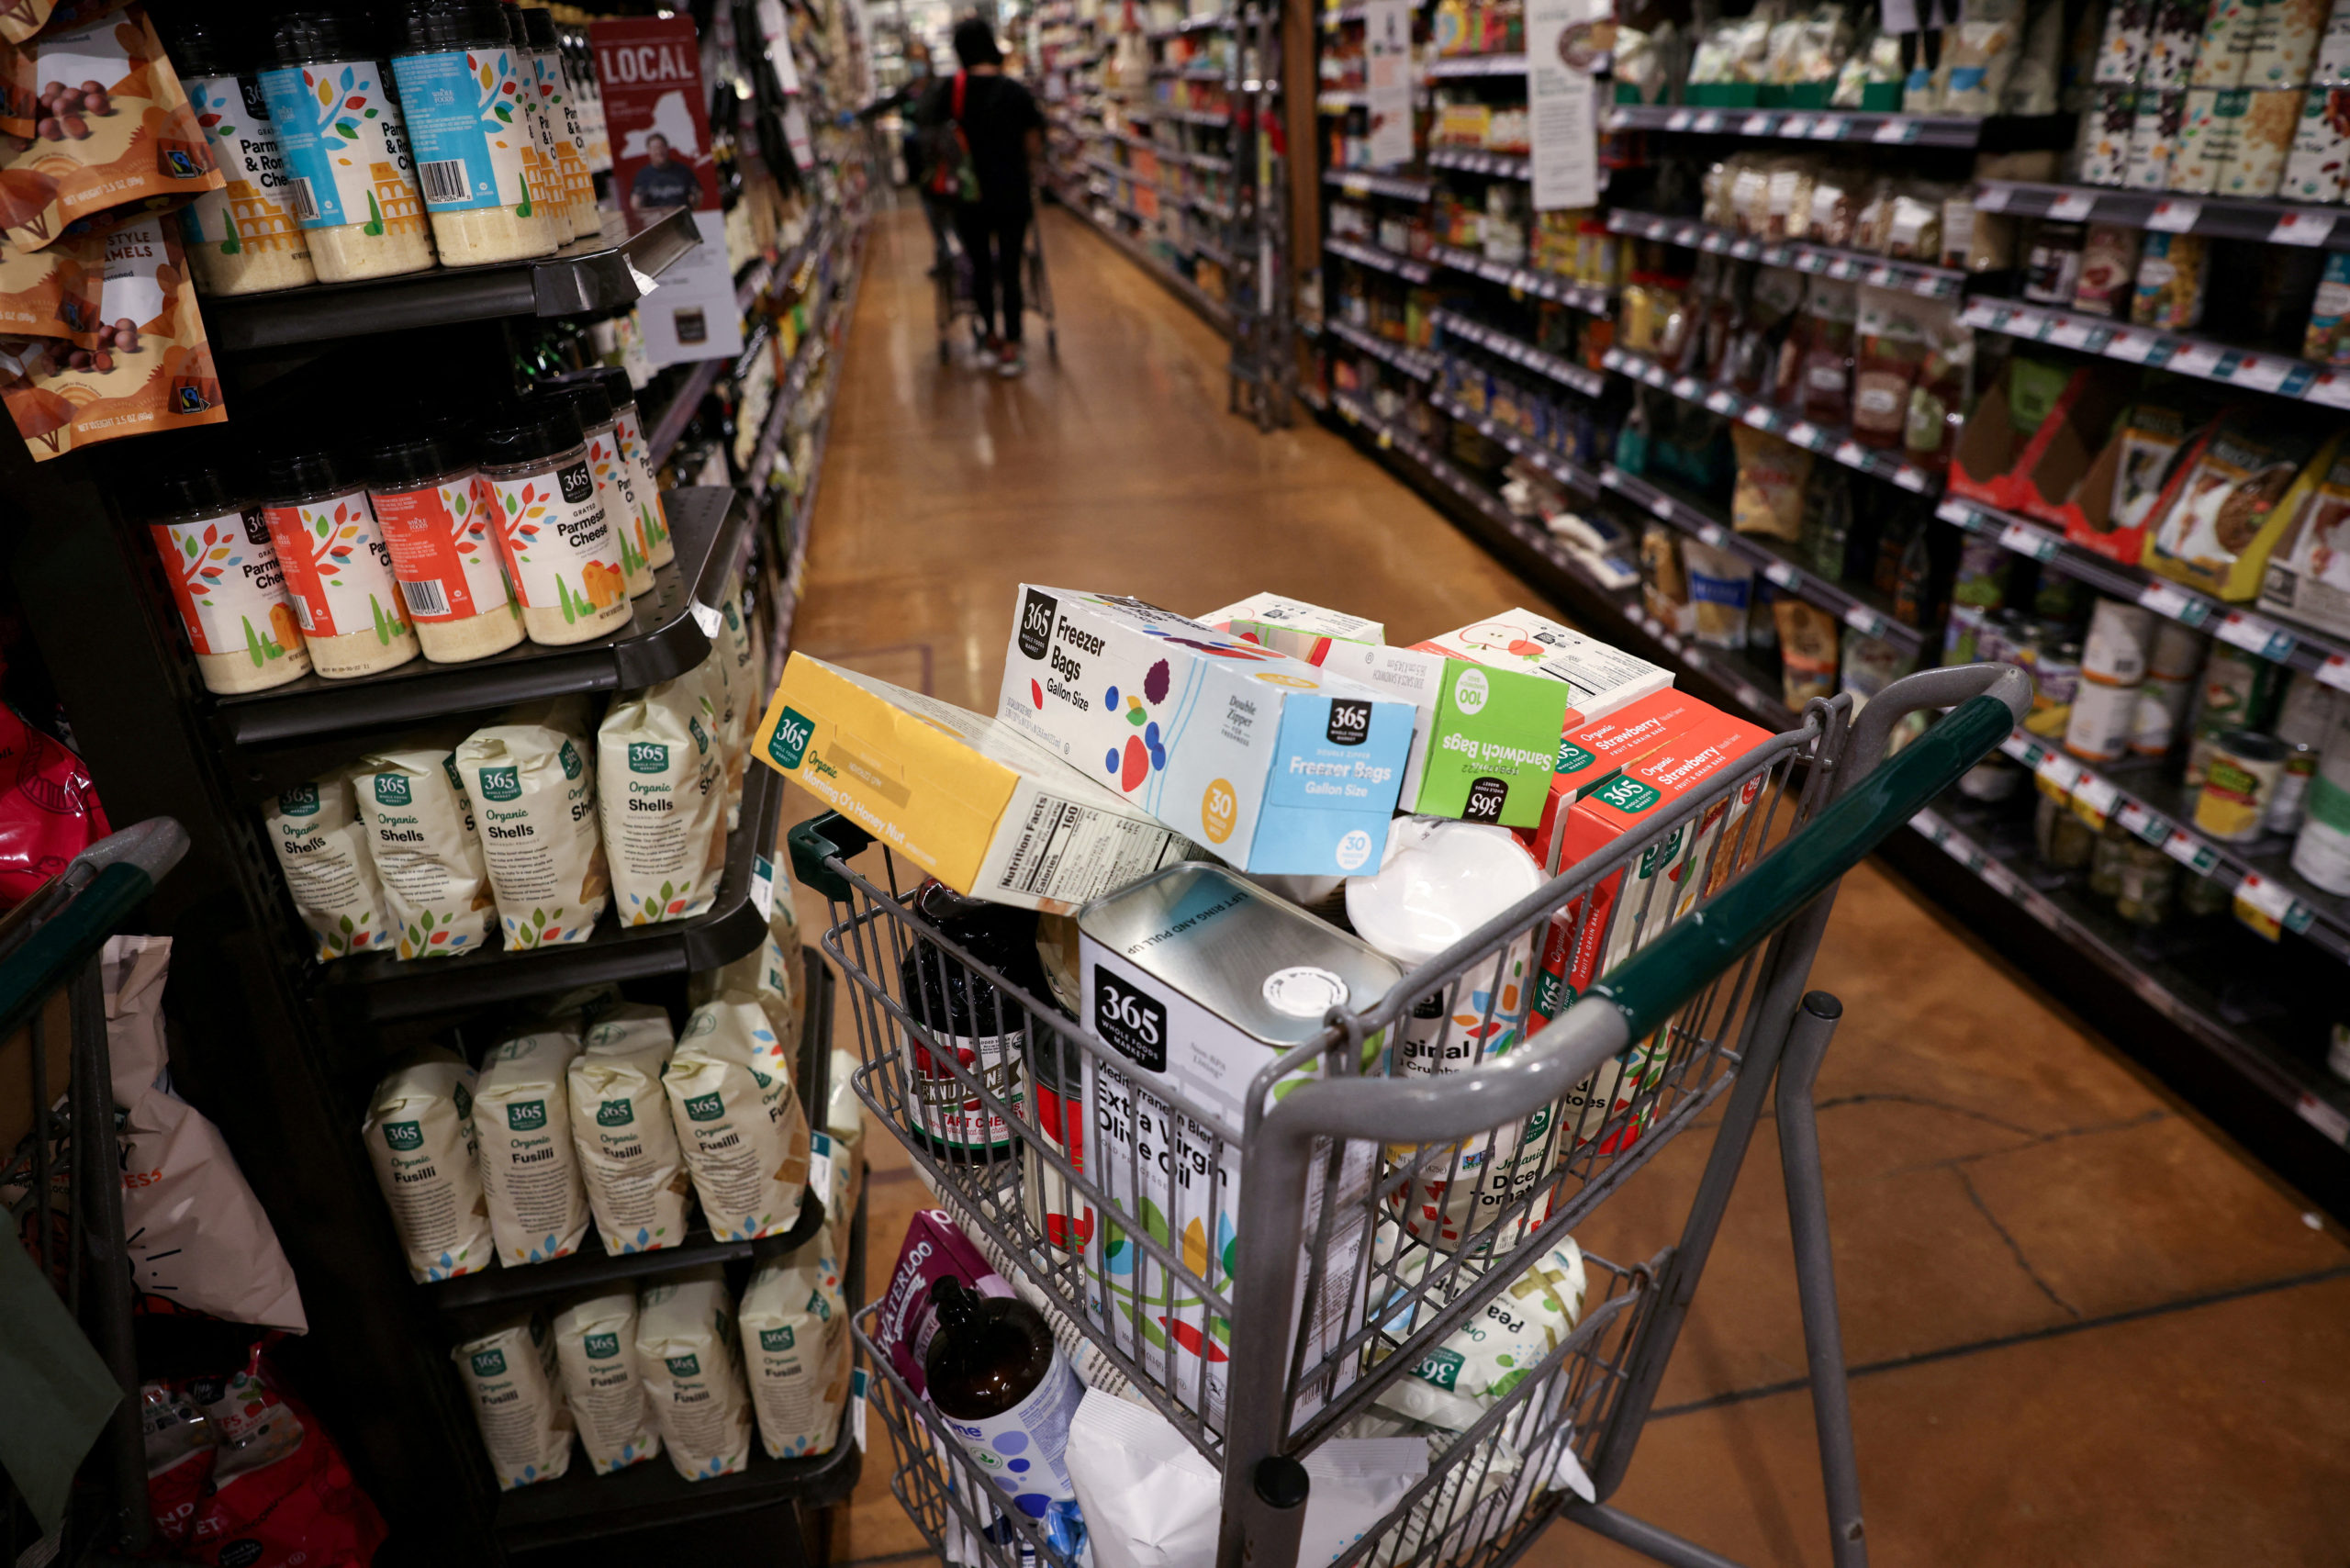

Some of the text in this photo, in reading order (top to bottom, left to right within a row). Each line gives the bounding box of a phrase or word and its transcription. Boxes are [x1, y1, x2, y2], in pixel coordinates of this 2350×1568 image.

[600, 47, 694, 84] LOCAL
[244, 84, 267, 106] 36
[386, 140, 397, 154] &
[245, 156, 259, 173] &
[260, 172, 288, 188] Che
[107, 231, 151, 246] STYLE
[563, 468, 588, 492] 365
[573, 503, 597, 518] GRATED
[248, 511, 266, 534] 36
[556, 507, 606, 537] Parmesan
[568, 523, 608, 548] Cheese
[1024, 601, 1052, 639] 365
[1022, 633, 1035, 644] WHOLE
[1056, 614, 1105, 657] Freezer
[1051, 645, 1081, 683] Bags
[1046, 678, 1089, 712] Gallon Size
[1460, 688, 1483, 706] 100
[1228, 695, 1257, 717] Double
[1225, 708, 1254, 729] Zipper
[1331, 706, 1367, 731] 365
[777, 718, 808, 752] 365
[1580, 723, 1616, 743] Organic
[1595, 716, 1662, 751] Strawberry
[632, 745, 665, 762] 365
[1442, 733, 1553, 772] Sandwich Bags
[1609, 745, 1628, 756] FRUIT
[808, 750, 837, 779] Organic
[1288, 756, 1393, 784] Freezer Bags
[1640, 756, 1675, 778] Organic
[1657, 745, 1722, 787] Strawberry
[1673, 778, 1692, 791] FRUIT
[1695, 764, 1714, 778] GRAIN
[1711, 755, 1727, 769] BARS
[377, 778, 407, 795] 365
[484, 772, 515, 790] 365
[629, 780, 672, 796] Organic
[1304, 781, 1369, 799] Gallon Size
[282, 788, 315, 804] 365
[1603, 779, 1644, 807] 365
[628, 799, 674, 812] Shells
[801, 767, 839, 804] Morning
[855, 799, 888, 834] Honey
[887, 822, 905, 846] Nut
[1209, 788, 1232, 820] 30
[1469, 793, 1503, 817] 365
[377, 812, 420, 827] Organic
[486, 809, 529, 823] Organic
[380, 829, 425, 843] Shells
[488, 823, 534, 839] Shells
[285, 836, 327, 855] Shells
[1001, 795, 1048, 888] Nutrition Facts
[1035, 804, 1080, 895] Calories 160
[1344, 835, 1366, 852] 30
[1127, 890, 1249, 956] LIFT RING AND PULL UP
[1101, 985, 1159, 1046] 365
[1102, 1019, 1159, 1060] WHOLE FOODS
[1113, 1036, 1147, 1060] MARKET
[511, 1104, 543, 1122] 365
[599, 1103, 629, 1120] 365
[689, 1096, 719, 1114] 365
[1099, 1078, 1151, 1135] Exta
[387, 1126, 418, 1142] 365
[694, 1123, 733, 1138] Organic
[510, 1136, 551, 1150] Organic
[602, 1145, 643, 1159] Fusilli
[699, 1133, 740, 1152] Fusilli
[391, 1155, 431, 1170] Organic
[511, 1148, 554, 1164] Fusilli
[394, 1166, 436, 1183] Fusilli
[877, 1241, 933, 1357] WATERLOO
[1486, 1304, 1526, 1335] Pea
[587, 1334, 616, 1349] 365
[475, 1353, 502, 1369] 365
